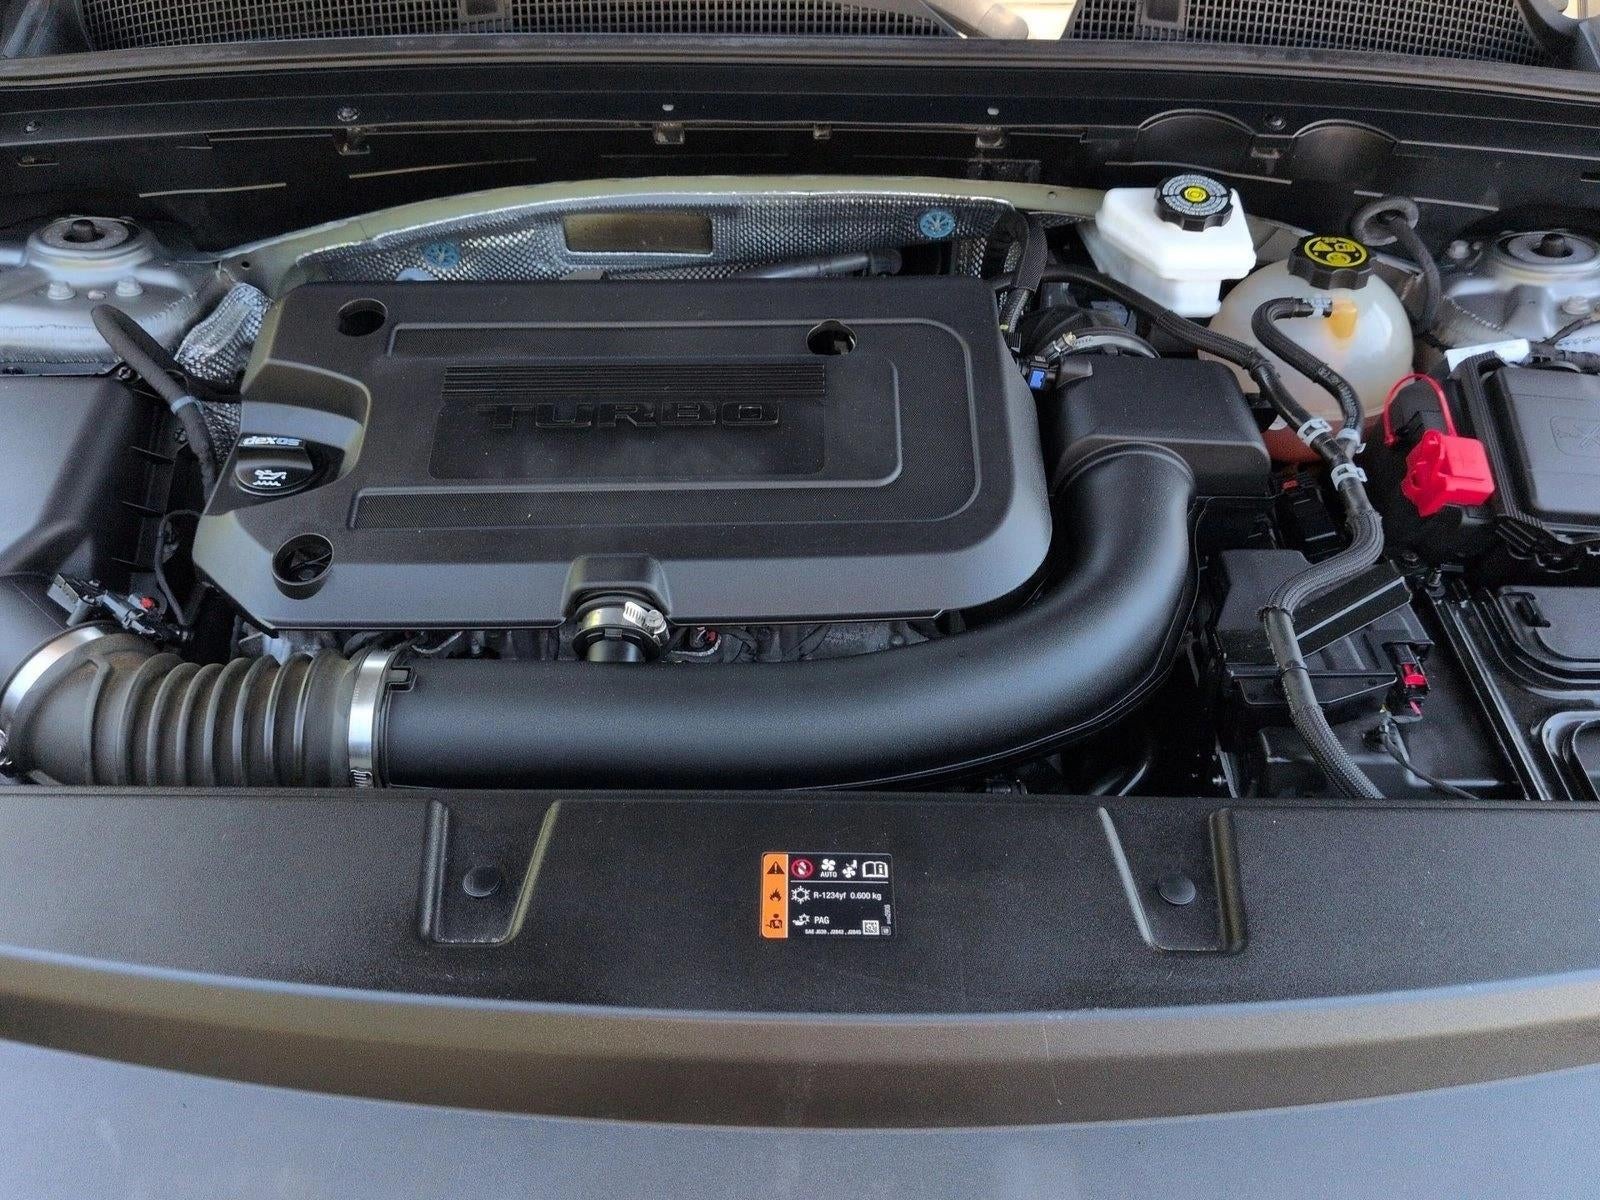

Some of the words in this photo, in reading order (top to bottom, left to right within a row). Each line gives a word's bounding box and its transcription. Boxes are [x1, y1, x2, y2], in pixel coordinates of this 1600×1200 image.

[477, 401, 780, 429] TURBO
[242, 436, 301, 447] dexos
[813, 891, 847, 900] R-1234yf
[850, 891, 871, 900] 0.600
[872, 892, 882, 901] kg
[814, 916, 830, 924] PAG
